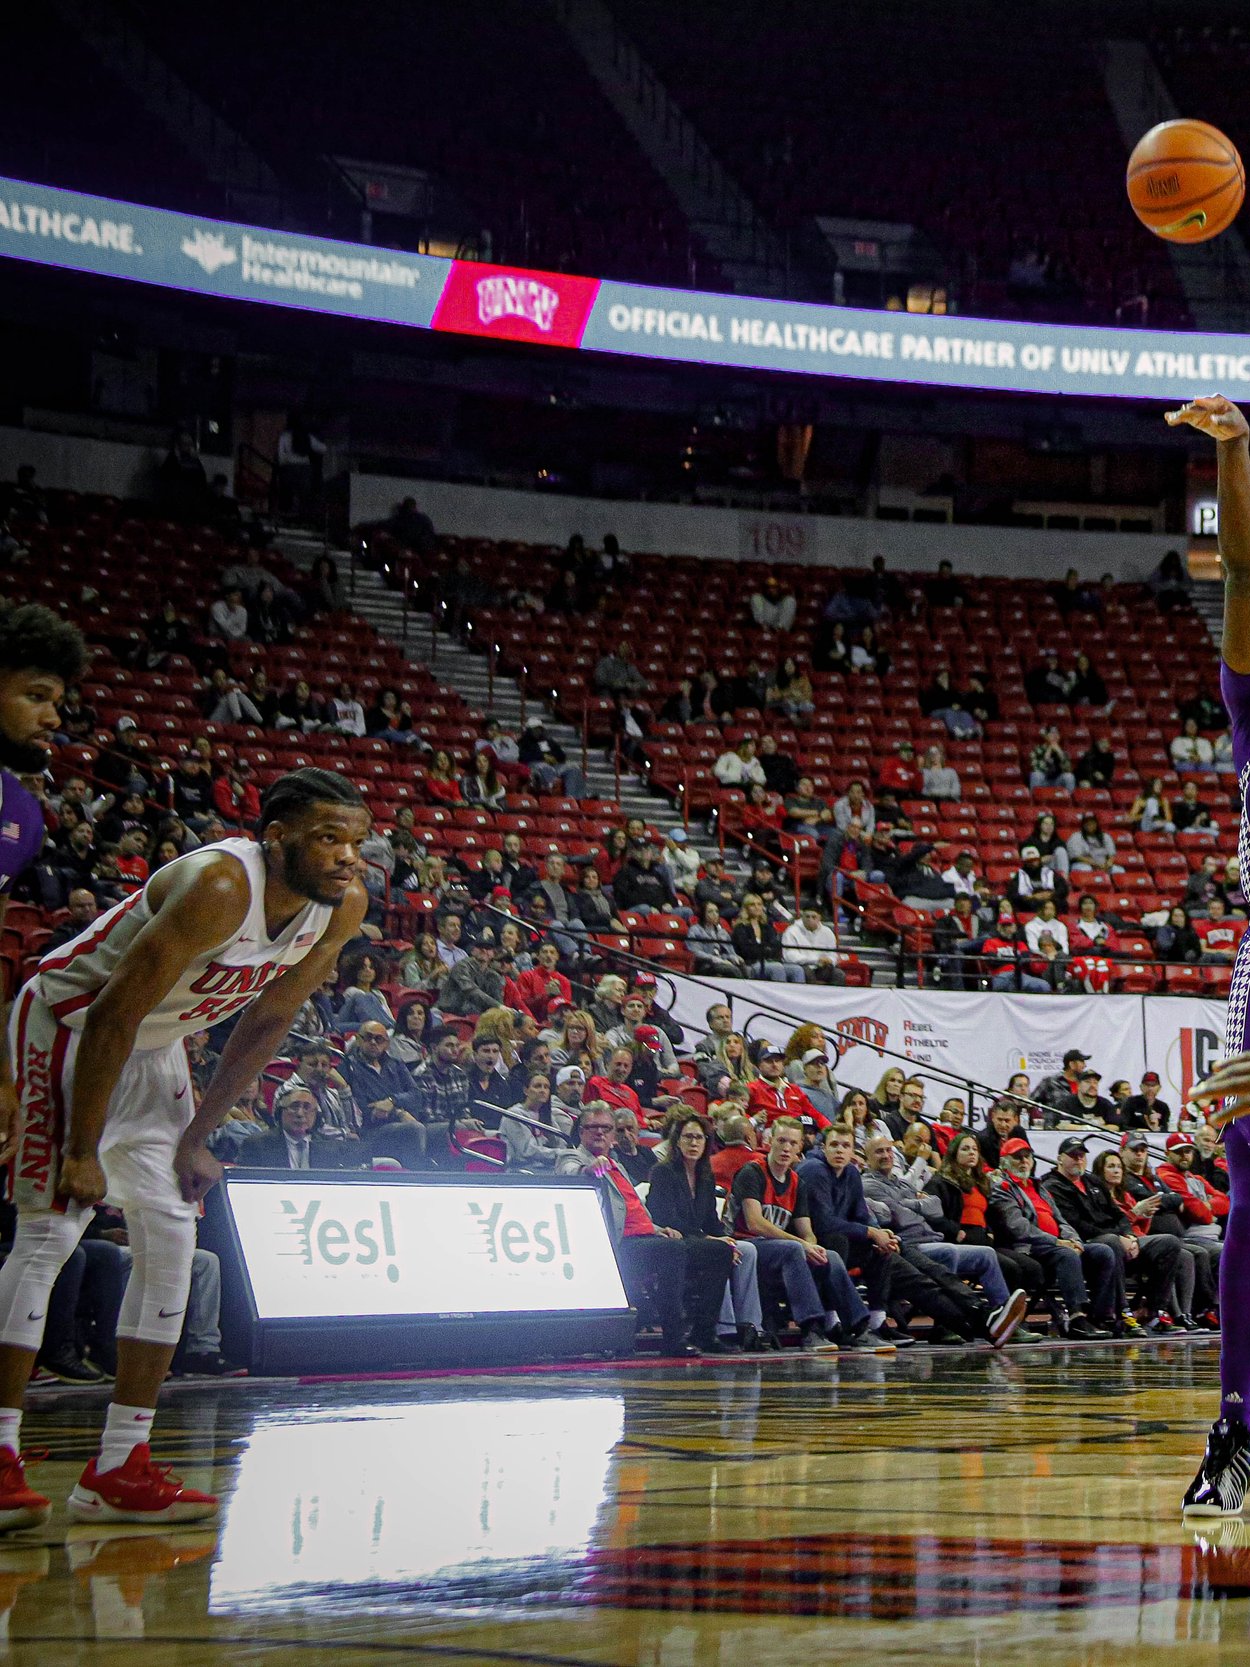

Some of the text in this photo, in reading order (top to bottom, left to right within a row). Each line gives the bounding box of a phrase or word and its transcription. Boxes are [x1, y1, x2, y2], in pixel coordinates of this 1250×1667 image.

[242, 233, 419, 288] Intermountain
[242, 258, 363, 298] Healthcare
[608, 303, 723, 342] OFFICIAL
[731, 317, 894, 360] HEALTHCARE
[901, 334, 1016, 369] PARTNER
[1020, 345, 1054, 371] OF
[1061, 348, 1130, 375] UNLV
[190, 961, 288, 994] UNL
[274, 1200, 575, 1284] Yes! Yes!
